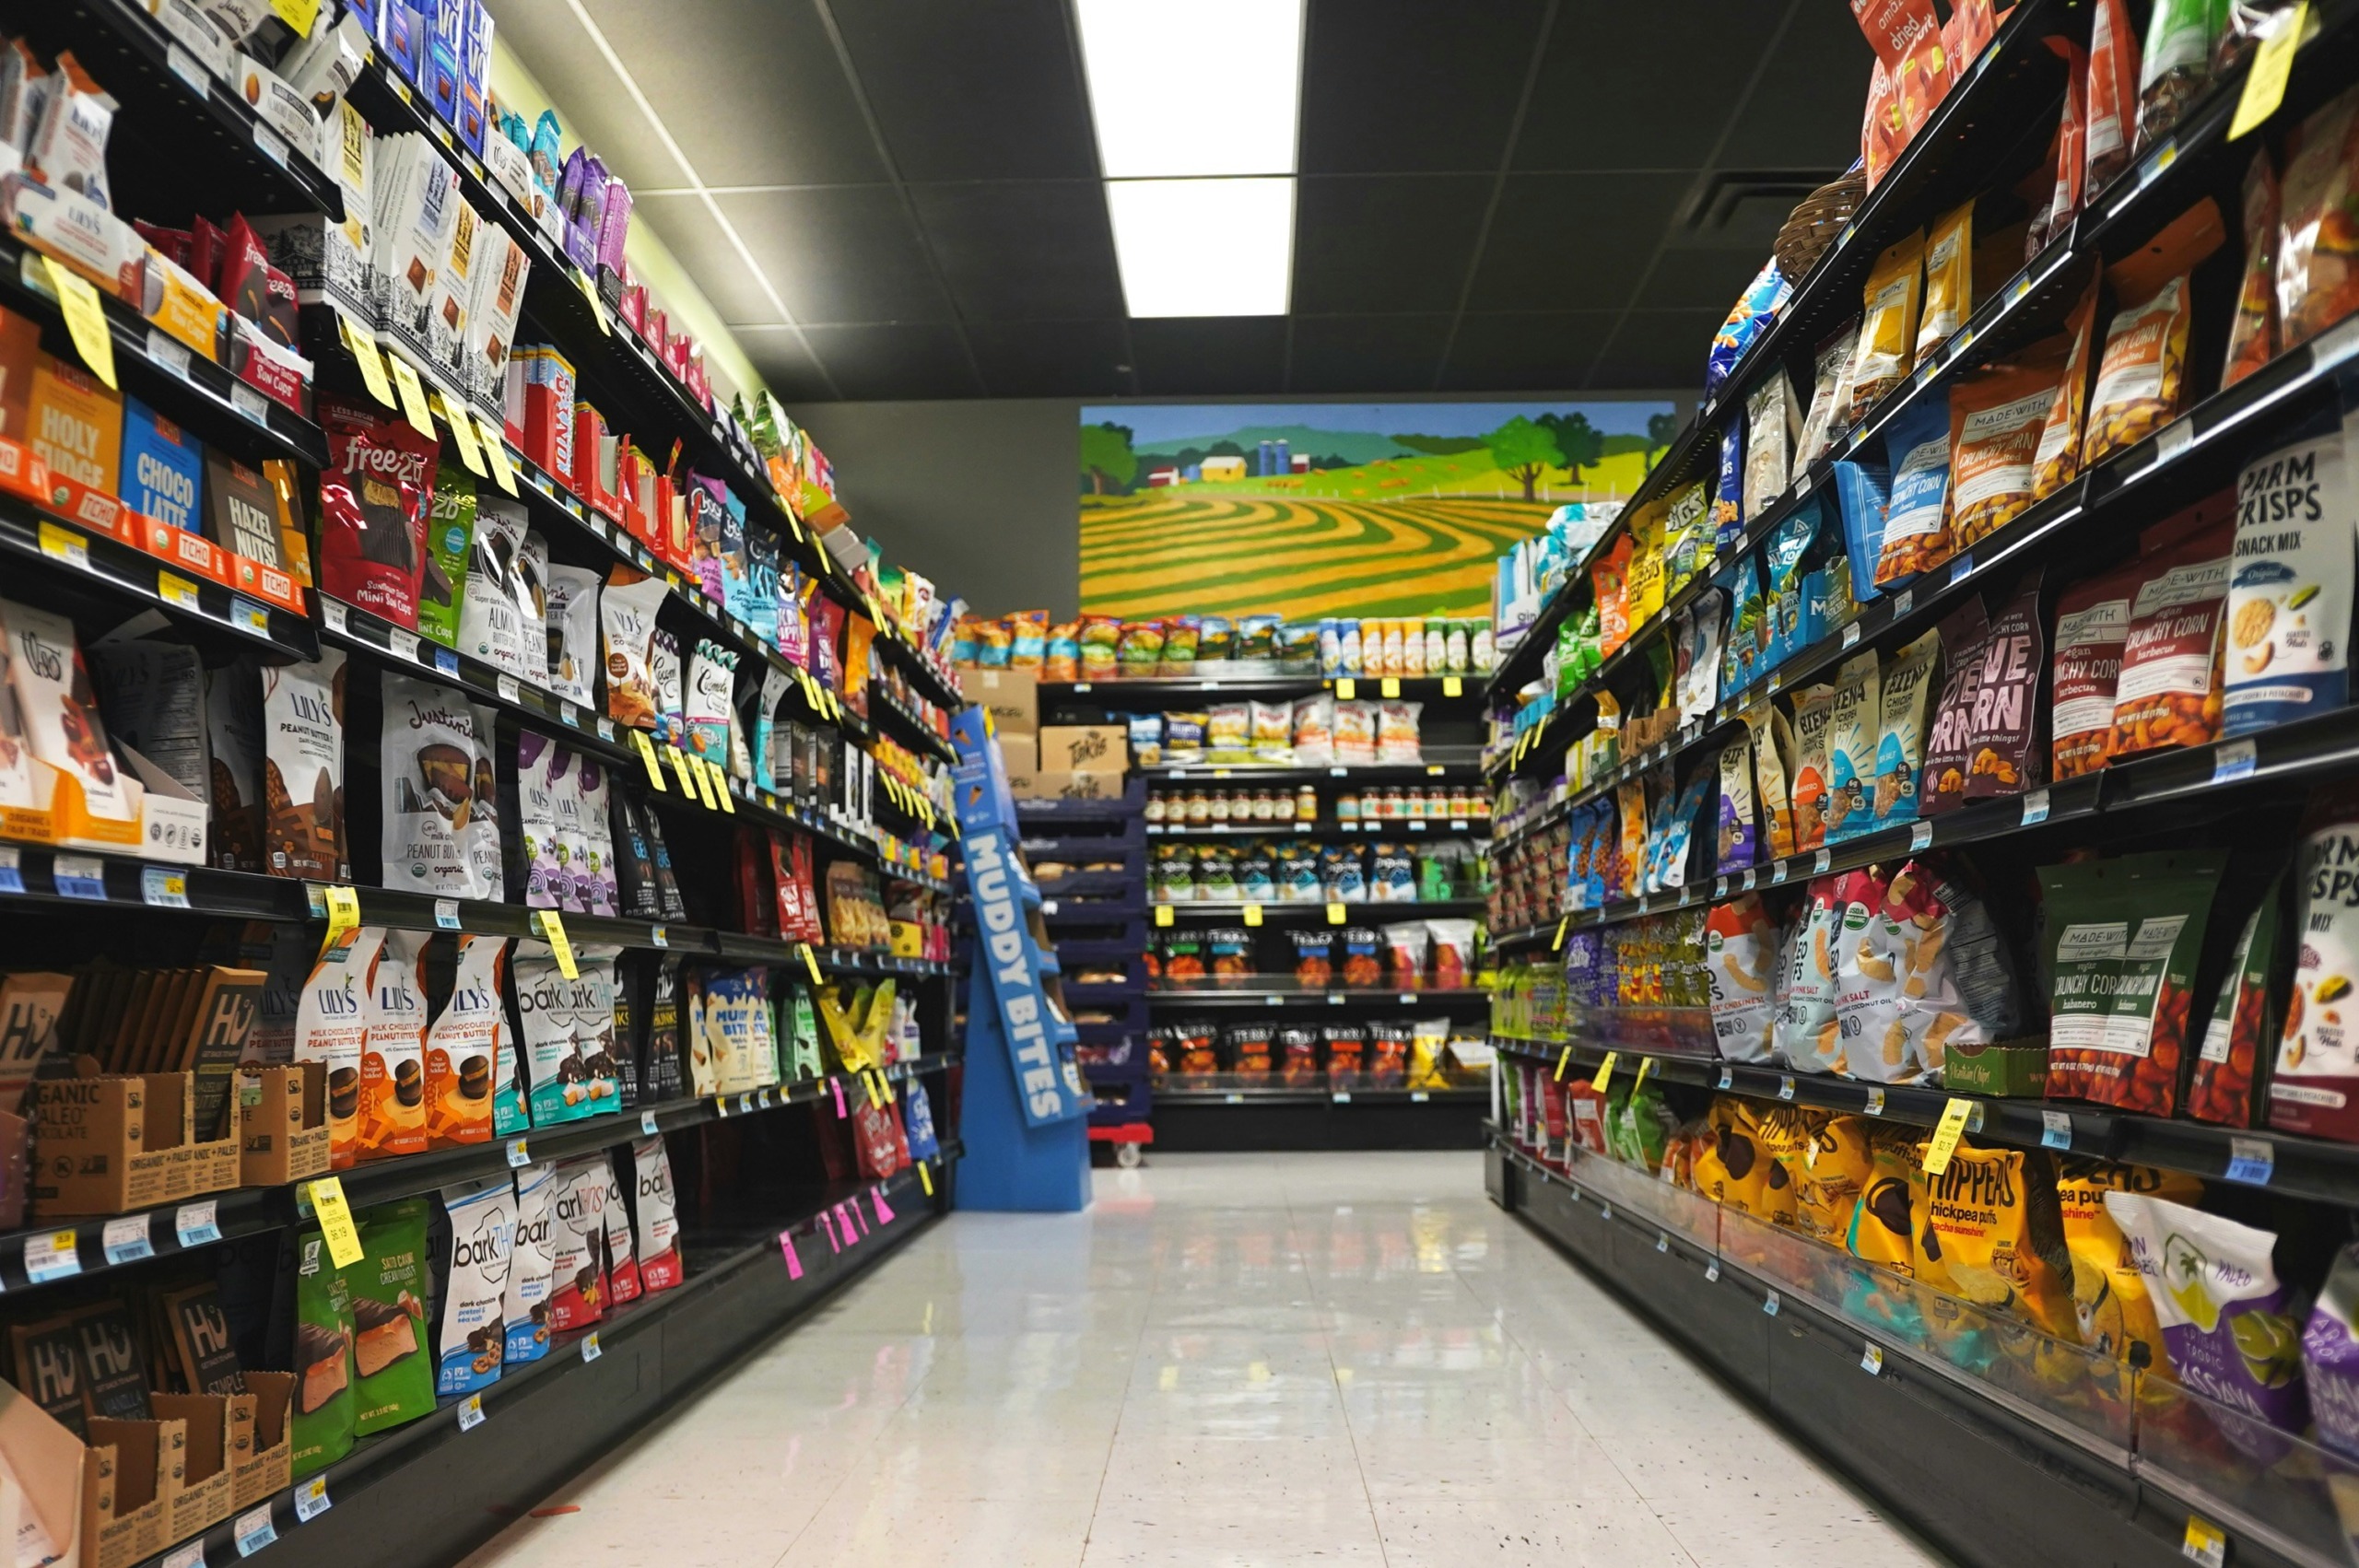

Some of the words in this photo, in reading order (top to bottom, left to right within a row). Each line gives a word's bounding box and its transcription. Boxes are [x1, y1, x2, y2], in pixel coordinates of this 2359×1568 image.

[1889, 12, 1920, 51] dried
[2130, 322, 2162, 349] CORN
[2119, 348, 2145, 367] salted
[41, 404, 100, 460] HOLY
[342, 437, 423, 483] free2b
[1958, 442, 2004, 470] CRUNCHY
[1961, 462, 1987, 479] roasted
[1994, 452, 2022, 466] salted
[136, 451, 194, 509] CHOCO
[1918, 474, 1943, 494] CORN
[2240, 451, 2318, 499] PARM
[82, 496, 117, 525] TCHO
[2238, 482, 2323, 529] RISPS
[229, 496, 275, 544] HAZEL
[181, 536, 210, 566] TCHO
[234, 527, 278, 570] NUTS!
[2235, 535, 2276, 557] SNACK
[2277, 530, 2302, 552] MIX
[263, 571, 290, 599] TCHO
[2011, 621, 2030, 632] CORN
[2126, 618, 2171, 653] CRUNCHY
[2174, 613, 2210, 638] CORN
[1984, 635, 2032, 684] VE
[2136, 643, 2177, 661] barbecue
[2059, 685, 2097, 698] barbecue
[407, 700, 475, 738] Justin's
[1972, 684, 2025, 733] RN
[2150, 707, 2170, 720] (170g)
[280, 722, 310, 736] PEANUT
[1991, 734, 2020, 743] things!
[406, 844, 440, 860] PEANUT
[434, 865, 464, 878] organic
[2309, 911, 2335, 933] MIX
[967, 832, 1033, 988] MUDDY
[1005, 993, 1062, 1120] BITES
[2054, 974, 2090, 997] CRUNCHY
[318, 989, 358, 1014] LILY'S
[453, 989, 490, 1012] ILY'S
[1808, 987, 1819, 995] SALT
[1824, 998, 1835, 1006] OIL
[1849, 990, 1870, 1001] SALT
[1852, 1002, 1880, 1012] COCONUT
[2062, 999, 2097, 1010] habanero
[308, 1037, 337, 1047] PEANUT
[370, 1031, 398, 1041] PEANUT
[434, 1030, 461, 1040] PEANUT
[464, 1028, 487, 1038] BUTTER
[1234, 1027, 1274, 1041] TERRA
[1927, 1153, 2016, 1208] HIPPEAS
[1978, 1208, 1998, 1225] puffs
[2215, 1258, 2252, 1287] PALEO
[458, 1307, 482, 1316] pretzel
[2185, 1340, 2225, 1371] TROPIC
